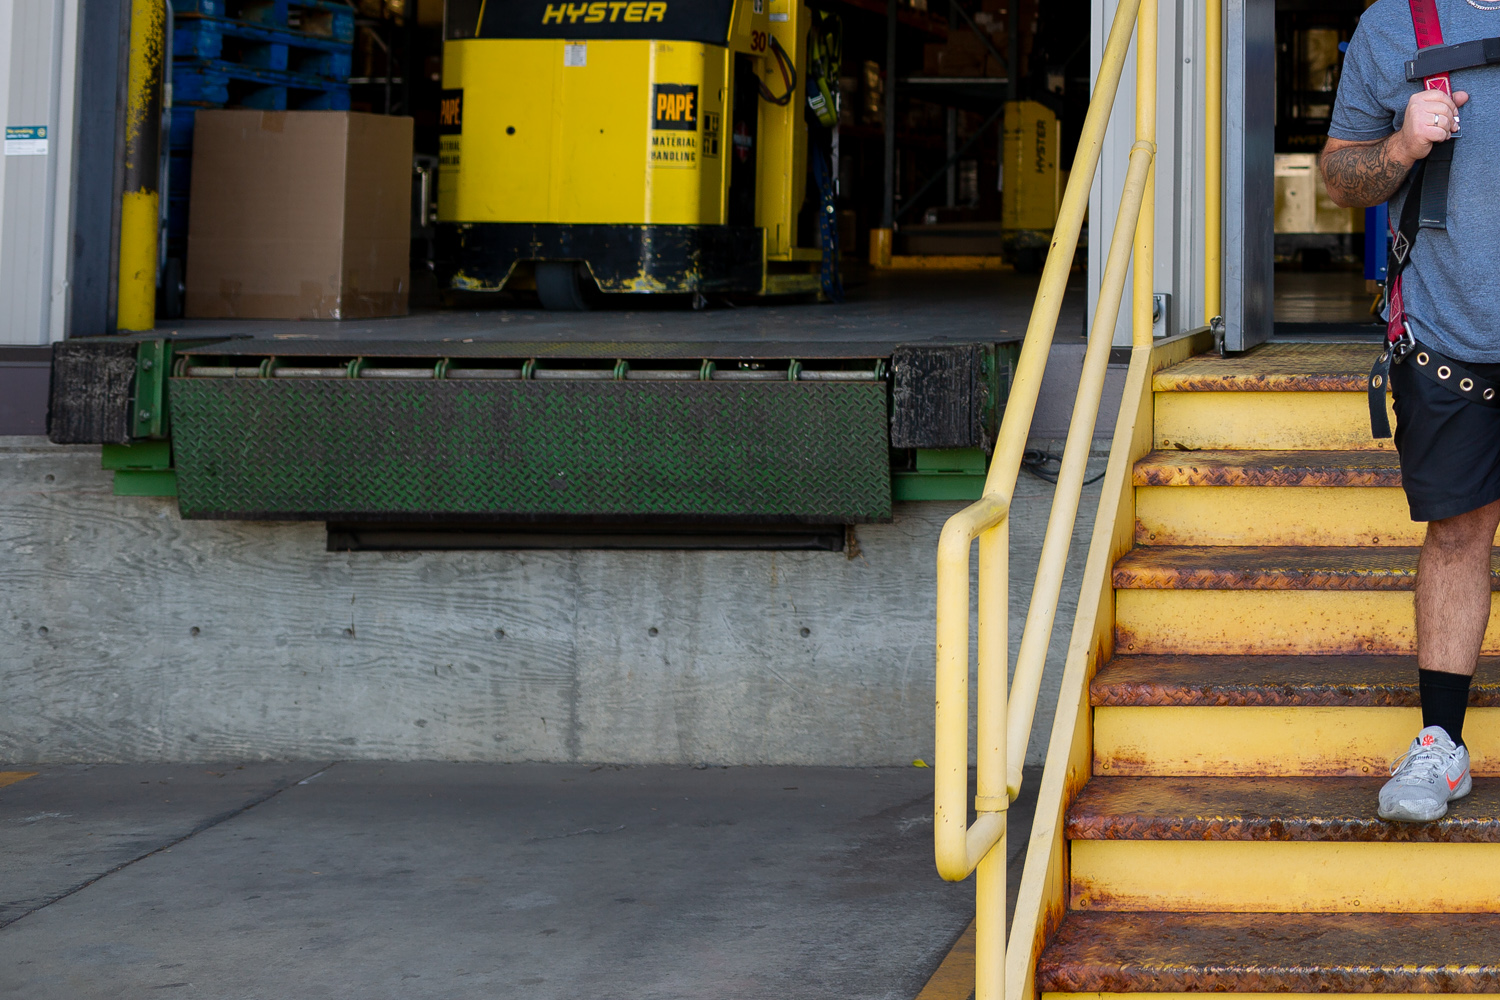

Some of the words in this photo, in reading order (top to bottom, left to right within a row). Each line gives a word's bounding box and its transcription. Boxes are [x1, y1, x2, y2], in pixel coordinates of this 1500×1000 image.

[542, 1, 668, 25] HYSTER
[750, 29, 766, 53] 30
[651, 136, 696, 149] MATERIAL
[1035, 119, 1046, 175] HYSTER
[651, 151, 696, 162] HANDLING
